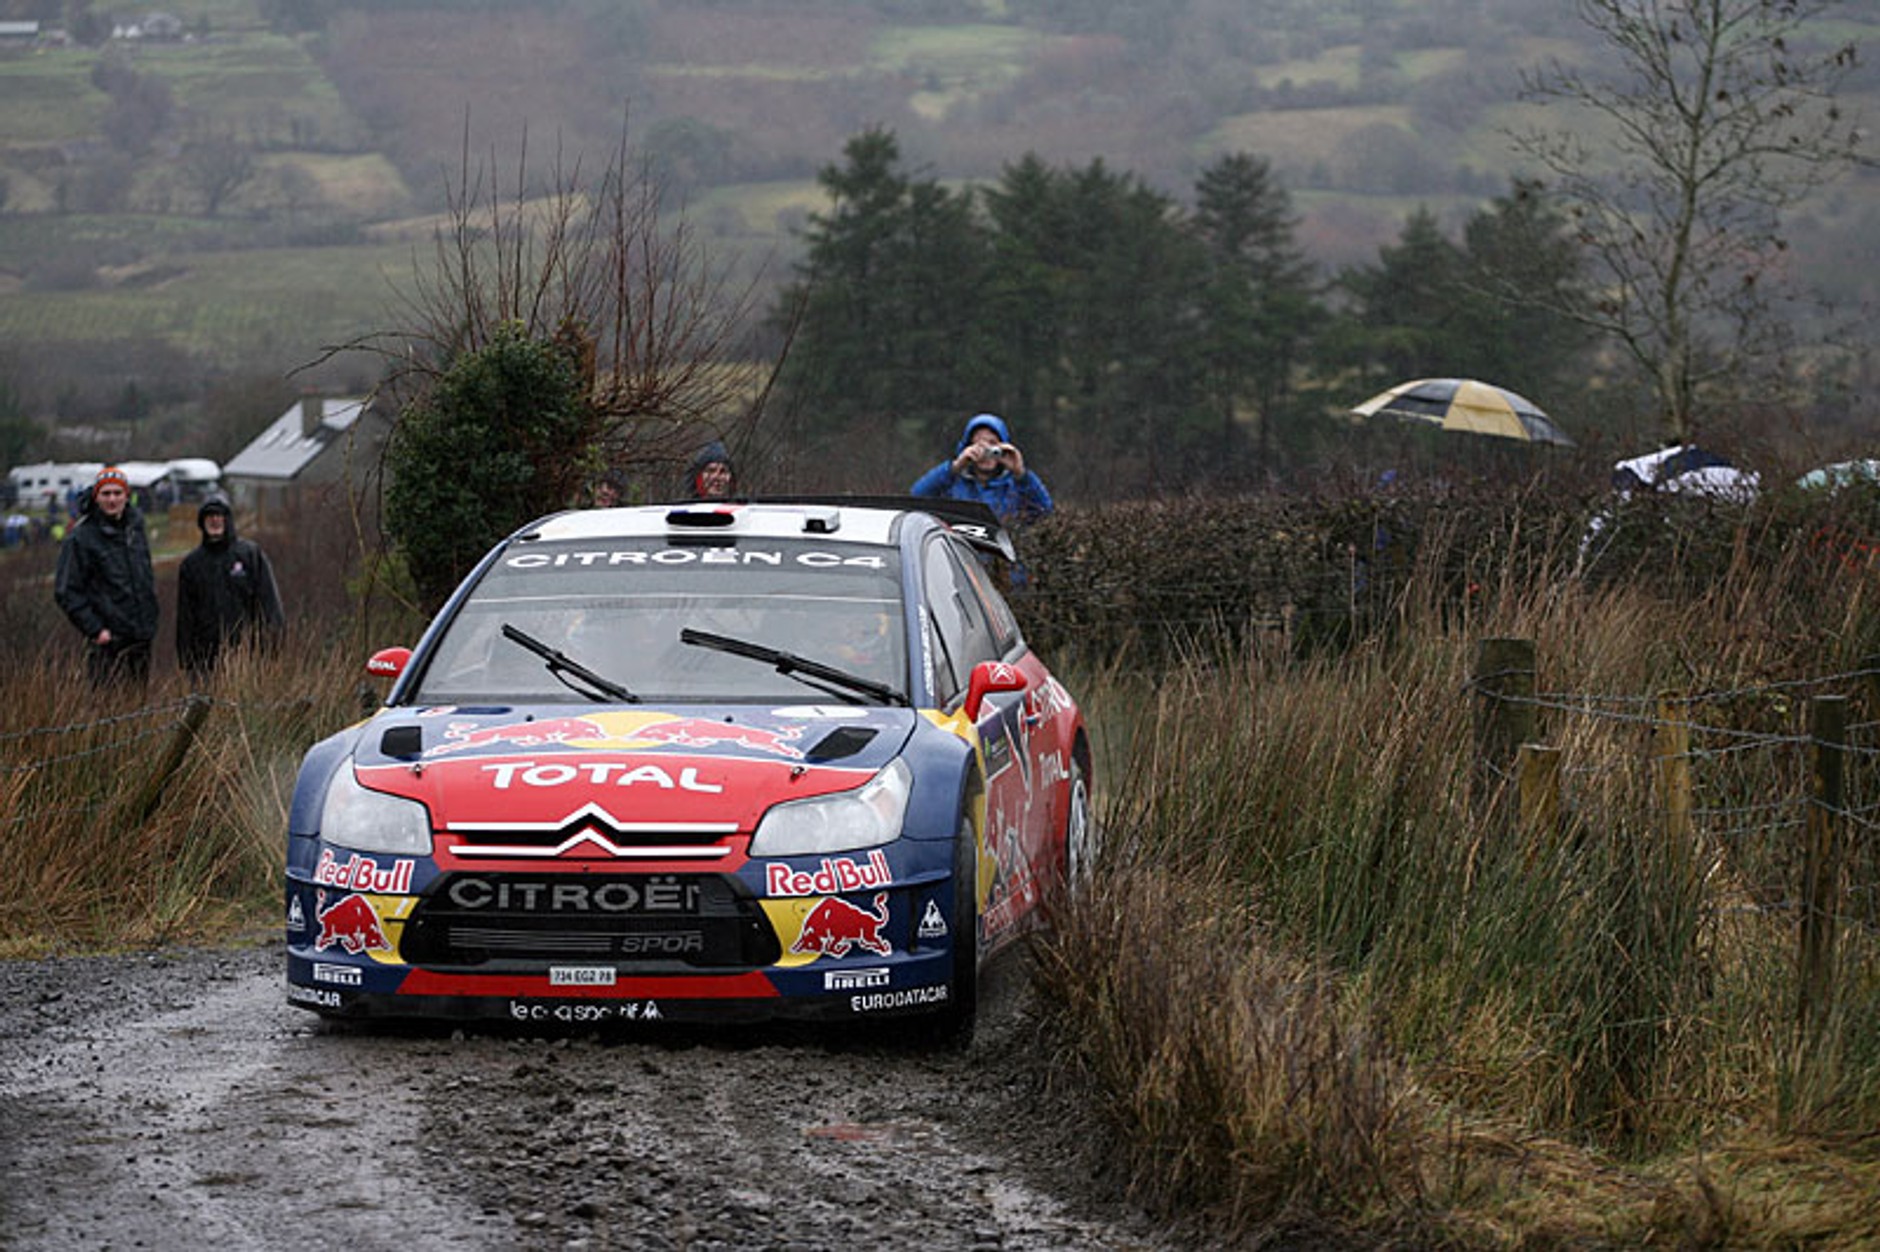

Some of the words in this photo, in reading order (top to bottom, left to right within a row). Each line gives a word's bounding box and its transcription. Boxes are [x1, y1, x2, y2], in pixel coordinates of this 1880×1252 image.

[506, 547, 782, 568] CITROËN
[796, 552, 887, 569] C4
[480, 761, 724, 793] TOTAL
[313, 963, 363, 986] PIRELLI
[823, 967, 890, 990] PIRELLI
